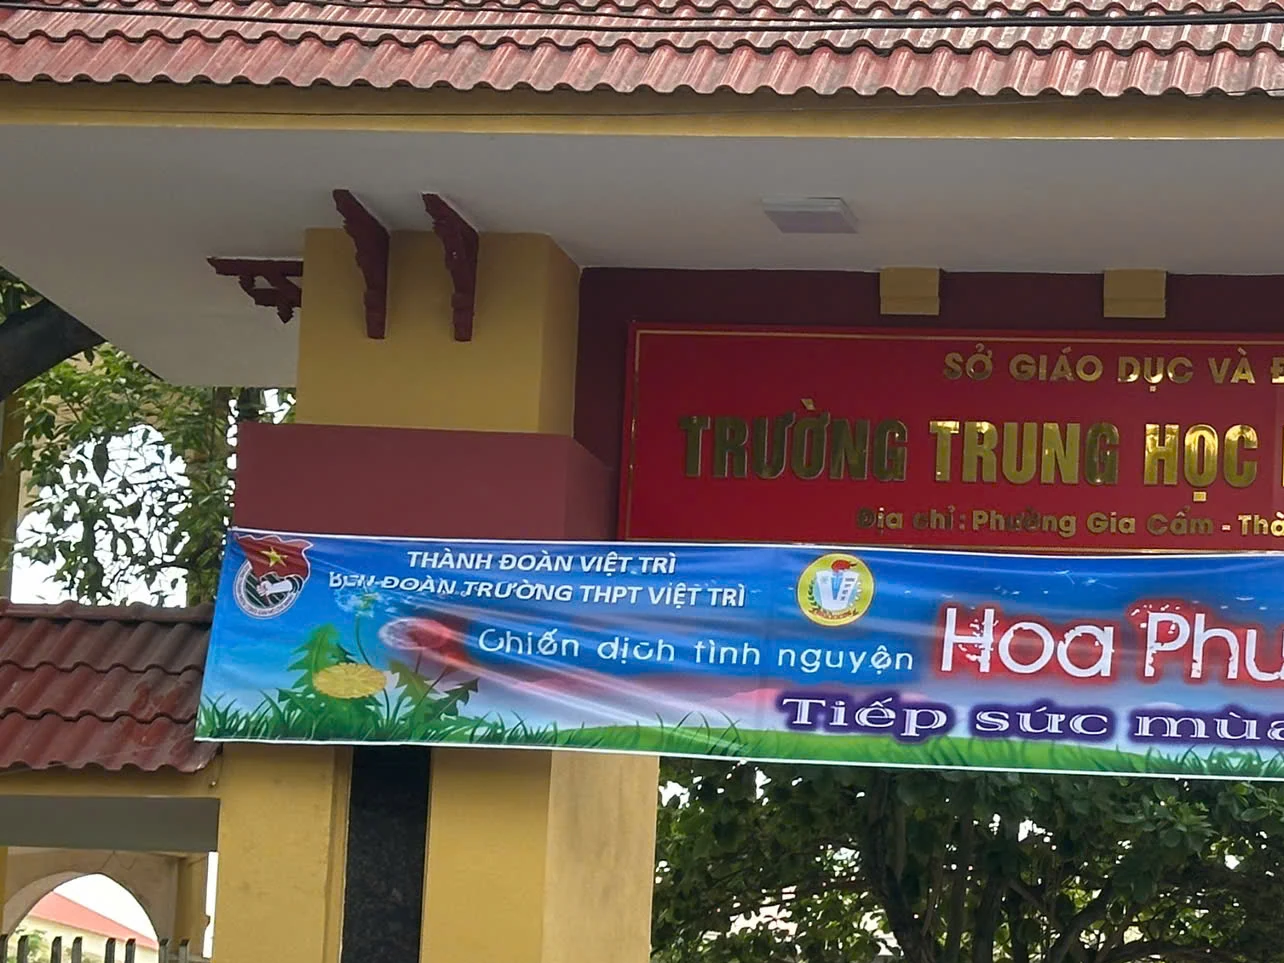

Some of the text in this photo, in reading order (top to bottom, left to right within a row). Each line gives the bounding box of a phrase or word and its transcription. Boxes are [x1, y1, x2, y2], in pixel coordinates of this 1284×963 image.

[943, 343, 993, 380] SỞ
[1009, 346, 1102, 381] GIÁO
[1117, 354, 1193, 392] DỤC
[1208, 347, 1255, 383] VÀ
[678, 398, 907, 482] TRƯỜNG
[929, 420, 1118, 485] TRUNG
[1143, 424, 1258, 501] HỌC
[857, 507, 903, 535] Địa
[972, 507, 1076, 537] Phường
[1086, 512, 1136, 534] Gia
[406, 547, 676, 575] THÀNH ĐOÀN VIỆT TRÌ
[462, 578, 573, 602] TRƯỜNG
[579, 585, 645, 605] THPT
[650, 582, 705, 608] VIỆT
[709, 584, 746, 606] TRÌ
[478, 628, 914, 676] Chiến dịch tình nguyện
[940, 606, 1115, 678] Hoa
[782, 697, 948, 737] Tiếp
[975, 705, 1108, 737] sức
